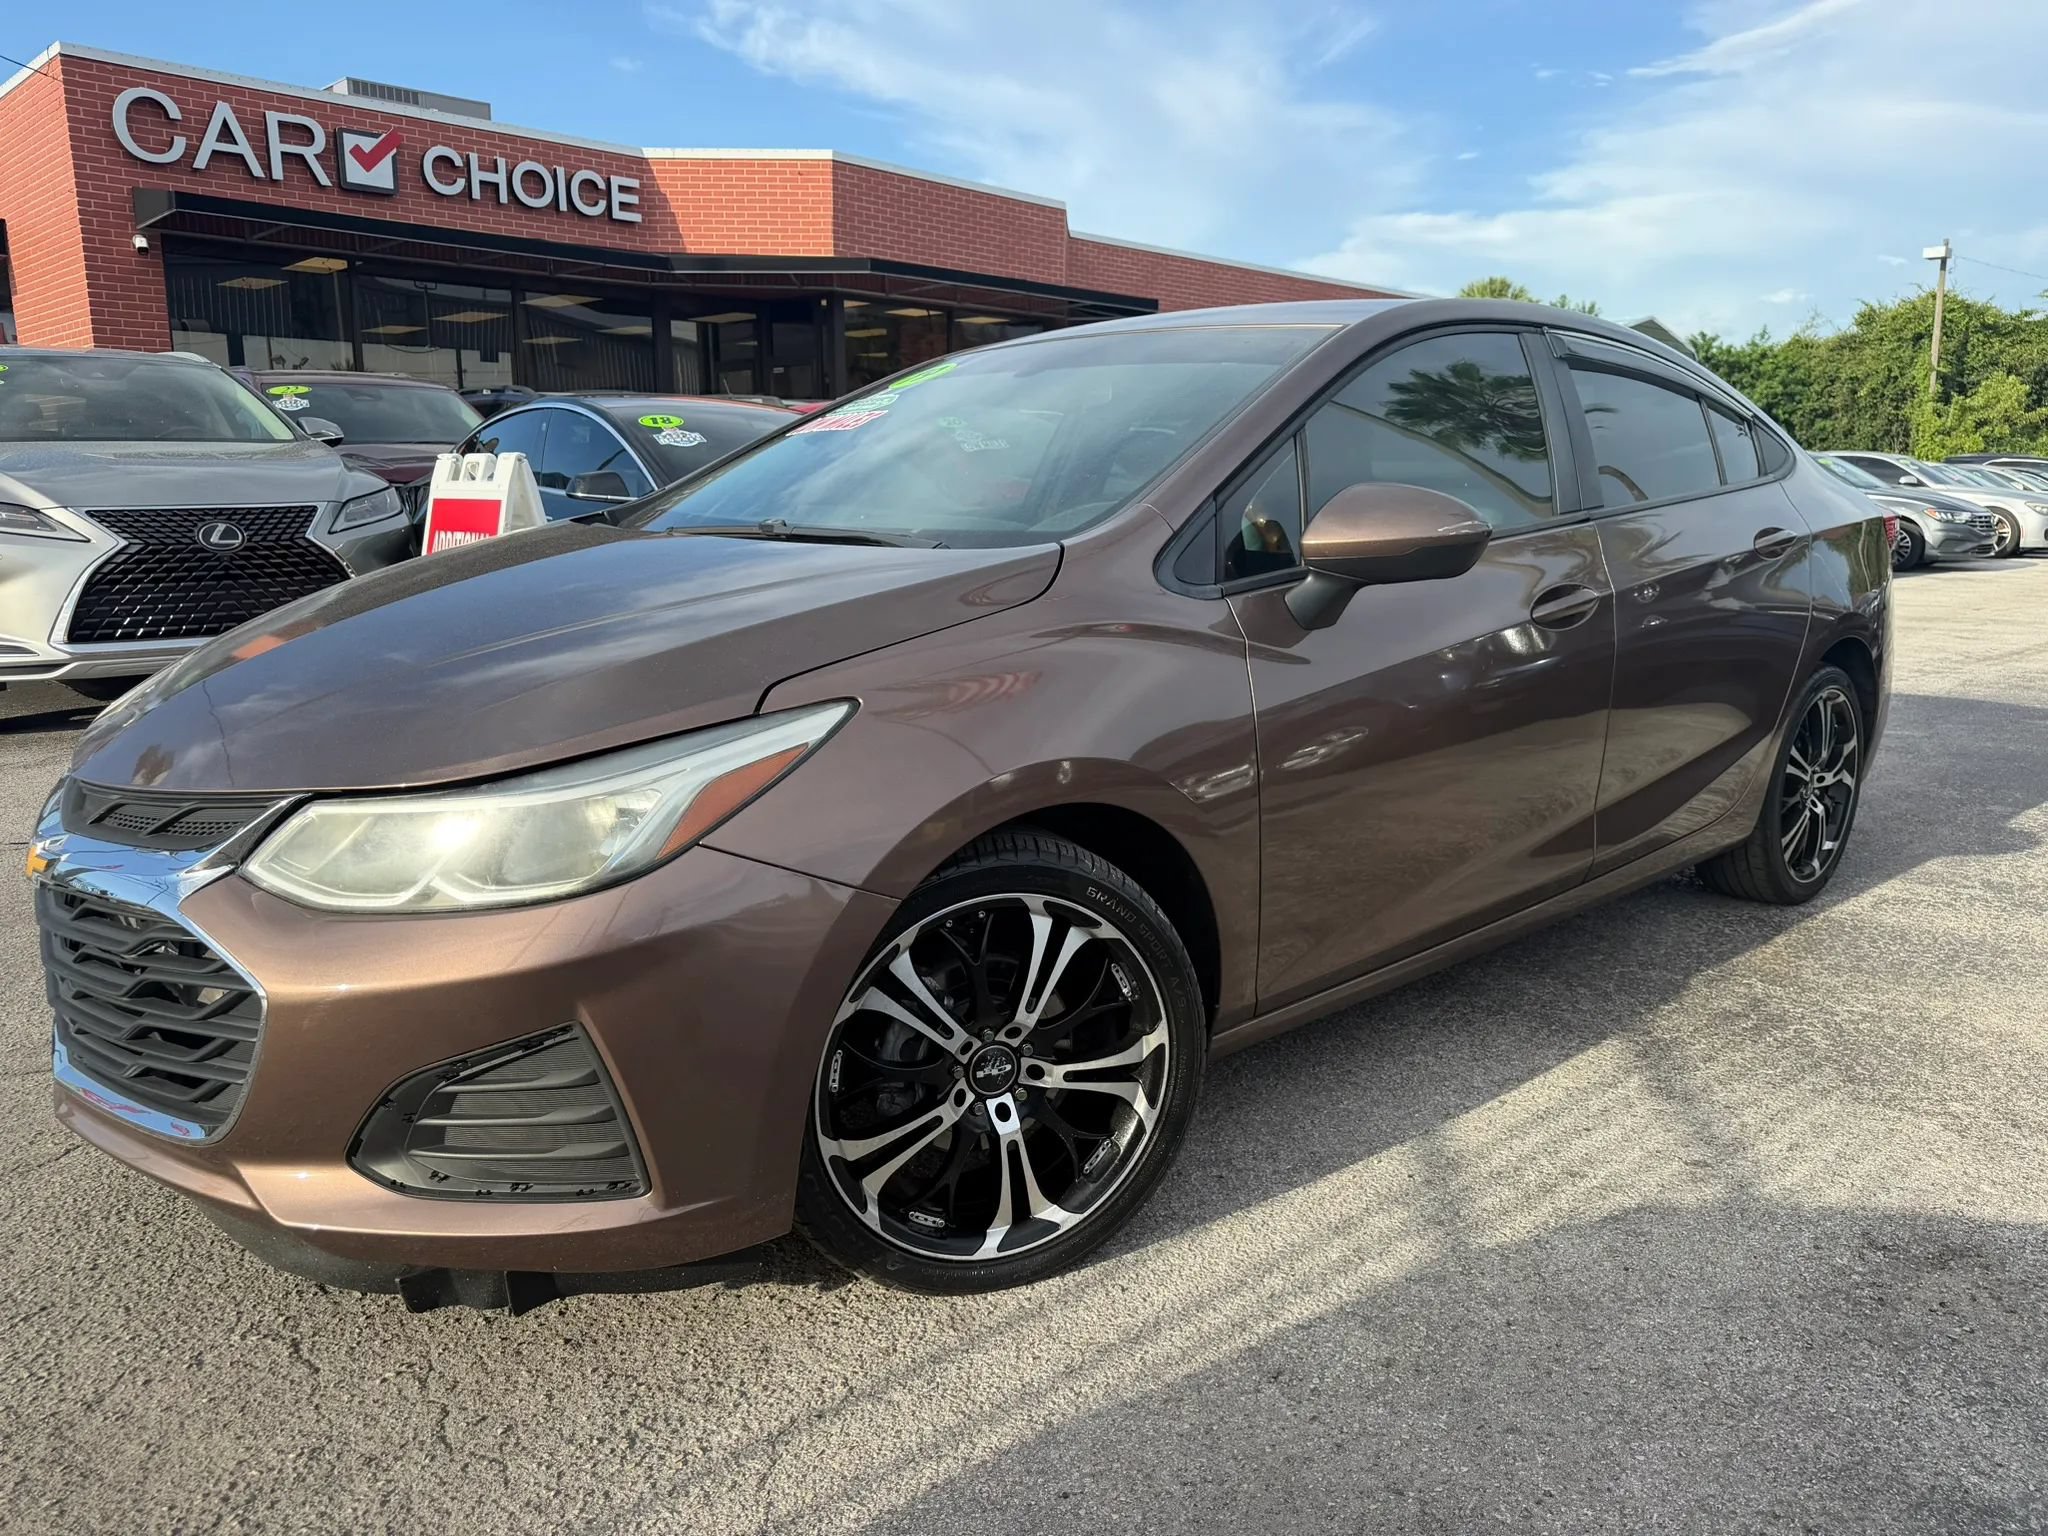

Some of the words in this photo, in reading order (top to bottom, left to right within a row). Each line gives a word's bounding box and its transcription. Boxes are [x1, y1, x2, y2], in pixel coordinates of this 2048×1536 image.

[112, 86, 333, 187] CAR
[422, 144, 643, 223] CHOICE
[431, 529, 489, 554] ADDITIO
[1086, 886, 1137, 923] GRAND
